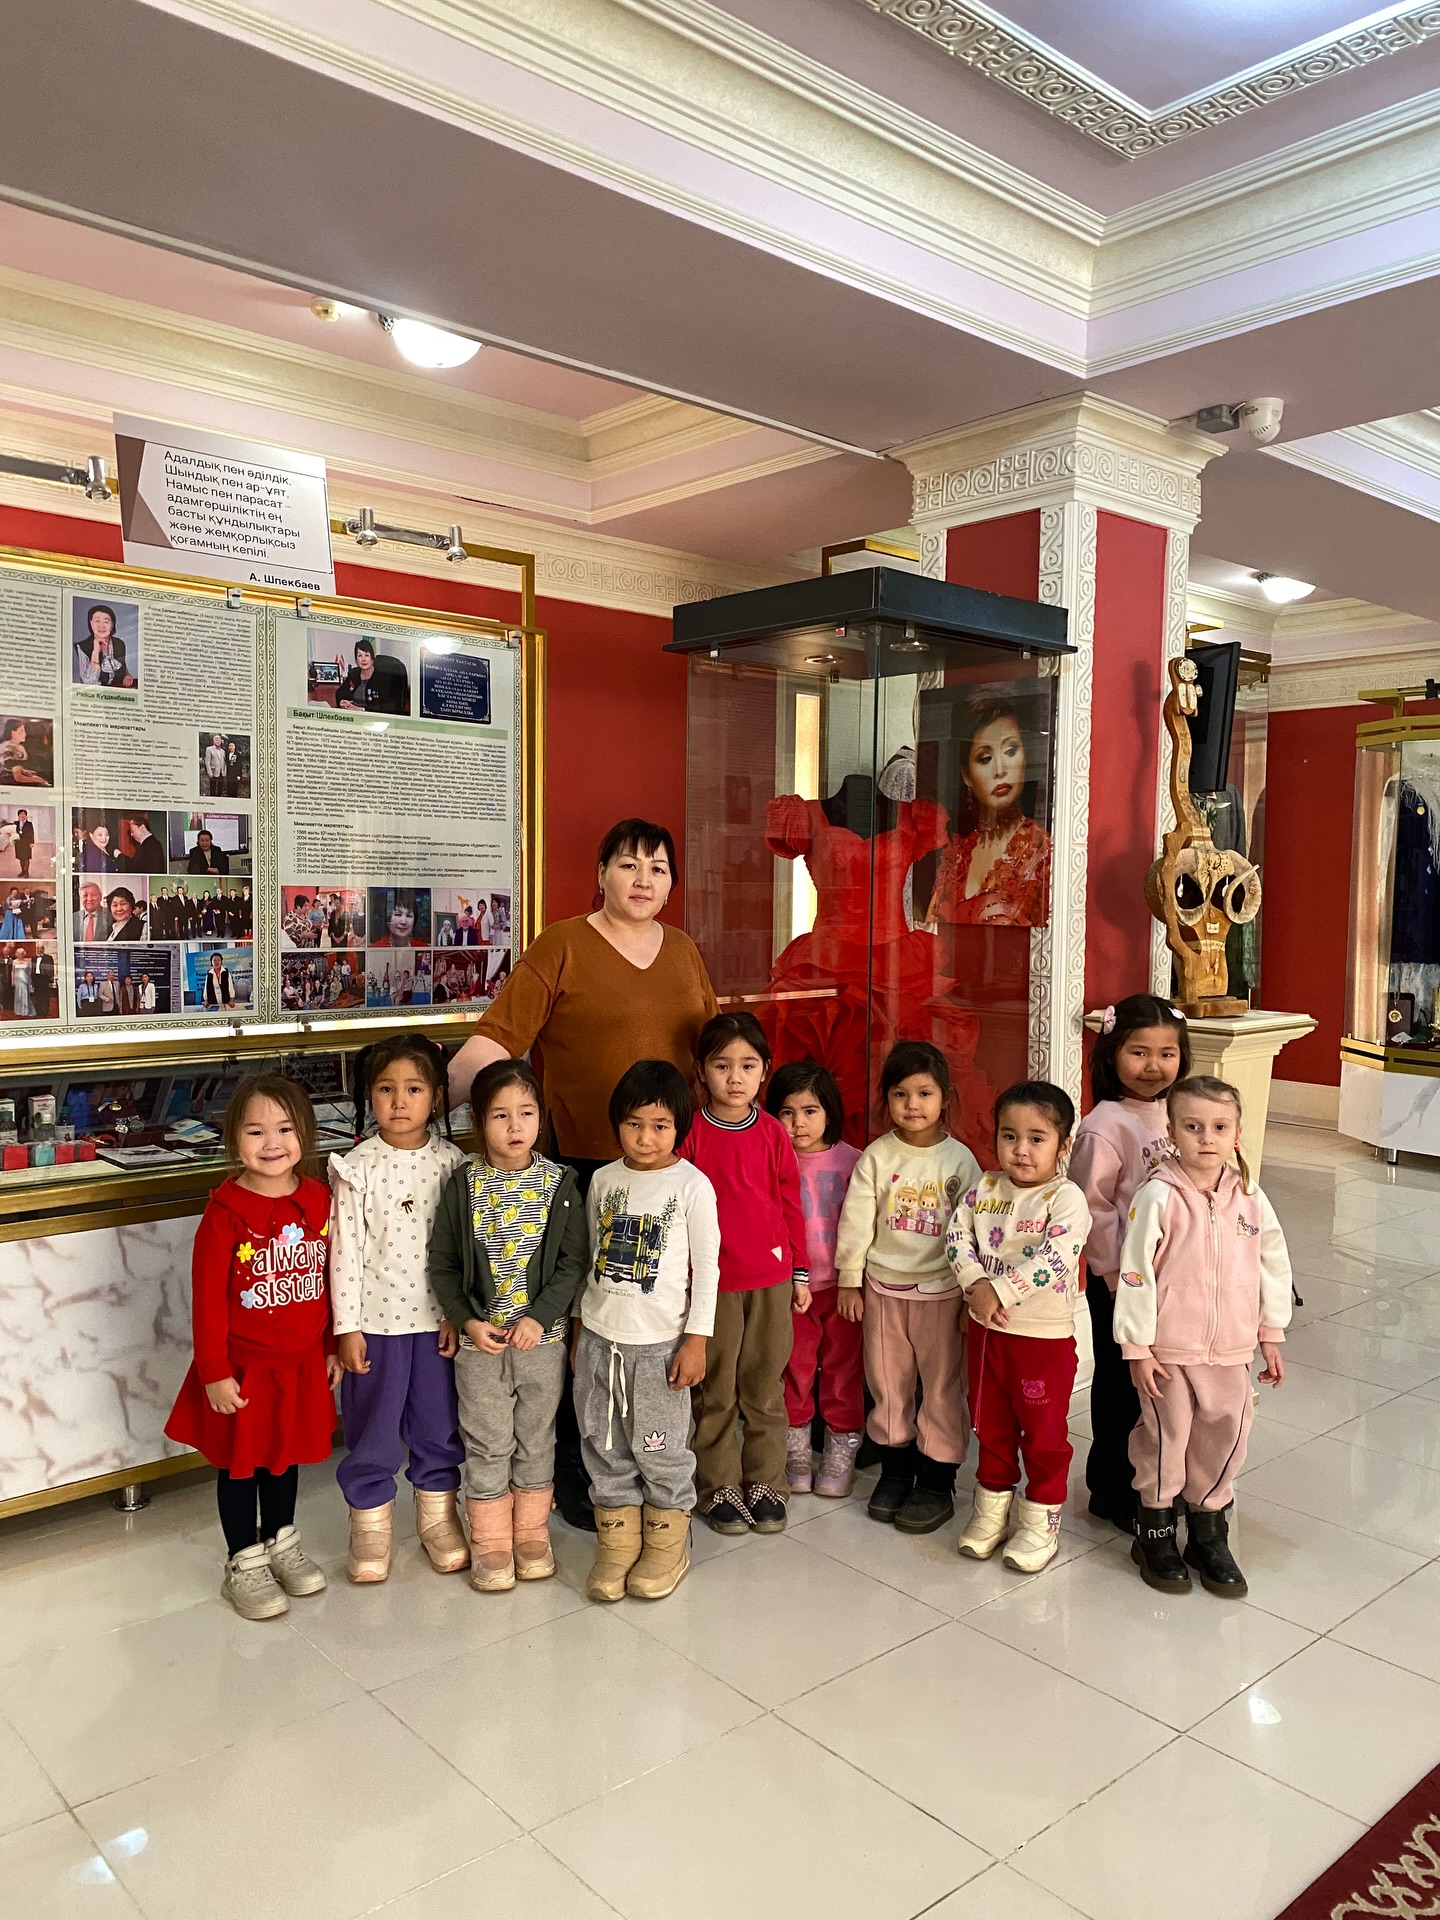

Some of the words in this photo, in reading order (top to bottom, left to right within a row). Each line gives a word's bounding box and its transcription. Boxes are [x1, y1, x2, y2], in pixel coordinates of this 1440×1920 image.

[164, 451, 221, 471] Адалдық
[224, 465, 245, 476] пен
[165, 464, 220, 485] Шындық
[222, 478, 243, 490] пен
[166, 478, 209, 495] Намыс
[211, 490, 233, 500] пен
[235, 494, 283, 509] парасат
[168, 506, 206, 521] басты
[209, 515, 300, 538] құндылықтары
[268, 513, 282, 523] ең
[169, 521, 202, 534] және
[204, 527, 296, 550] жемқорлықсыз
[170, 535, 230, 553] қоғамның
[249, 572, 261, 582] А.
[264, 574, 320, 591] Шпекбаев
